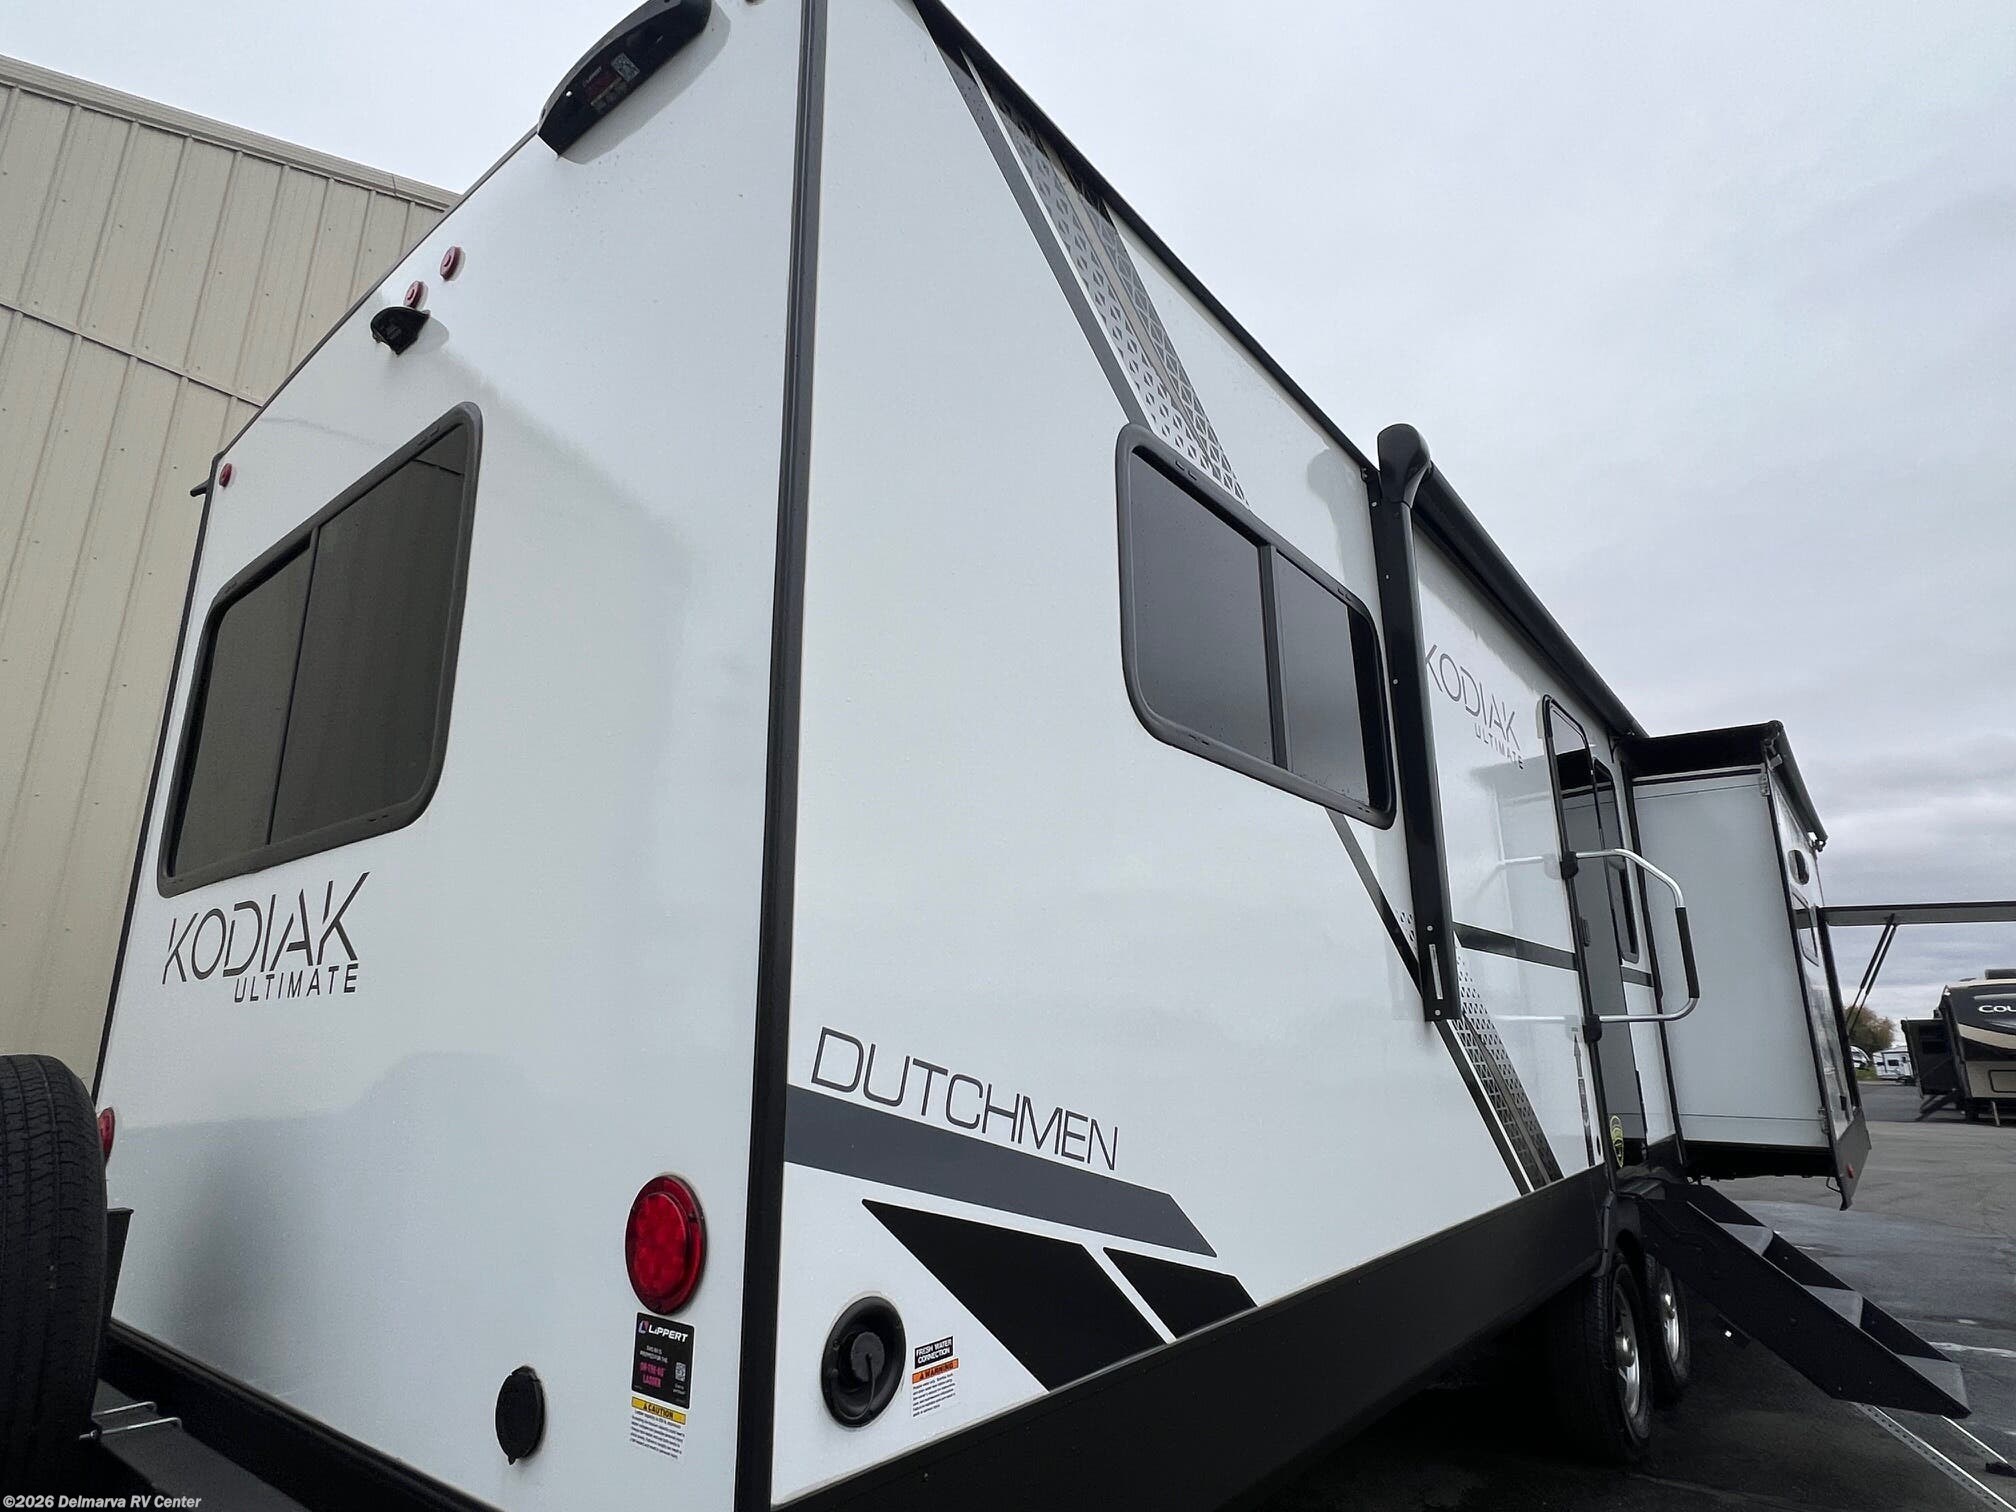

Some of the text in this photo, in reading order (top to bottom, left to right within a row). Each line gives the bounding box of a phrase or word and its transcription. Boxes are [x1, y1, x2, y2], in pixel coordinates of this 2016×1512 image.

[1425, 644, 1520, 751] KODIAK
[1474, 722, 1525, 769] ULTIMATE
[162, 871, 371, 985] KODIAK
[234, 963, 359, 1003] ULTIMATE
[811, 1026, 1119, 1170] DUTCHMEN
[916, 1339, 952, 1357] FRESH WATER
[917, 1346, 951, 1364] CONNECTION
[926, 1362, 953, 1378] WARNING
[648, 1403, 674, 1420] CAUTION
